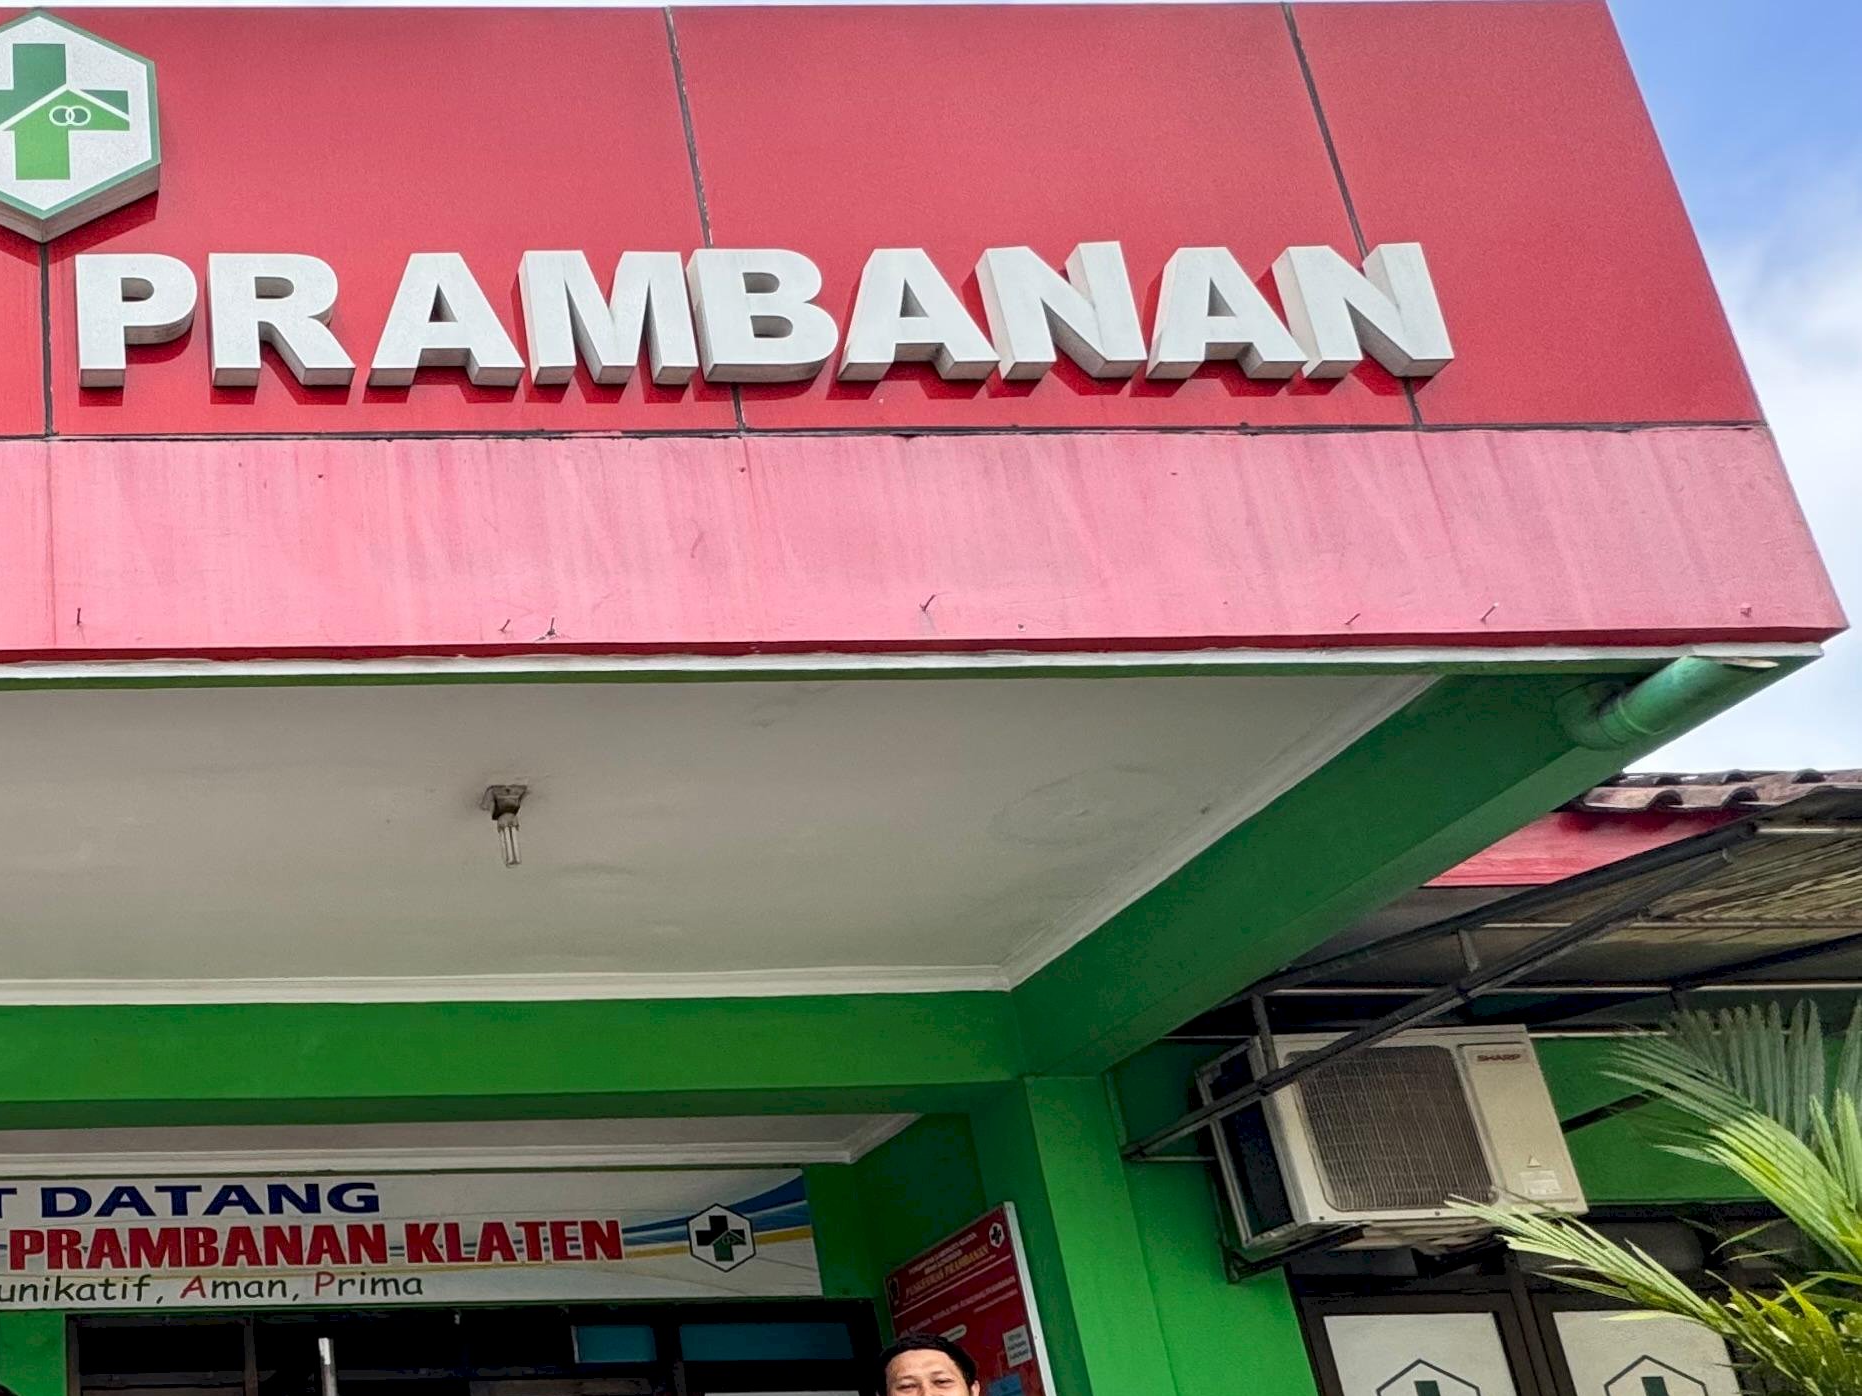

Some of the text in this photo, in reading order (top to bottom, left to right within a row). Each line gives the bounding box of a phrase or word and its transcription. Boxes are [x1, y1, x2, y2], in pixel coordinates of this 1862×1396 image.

[75, 241, 1455, 389] PRAMBANAN
[40, 1183, 380, 1219] DATANG
[8, 1224, 389, 1272] PRAMBANAN
[403, 1219, 624, 1264] KLATEN
[179, 1274, 299, 1302] Aman,
[314, 1270, 424, 1298] Prima
